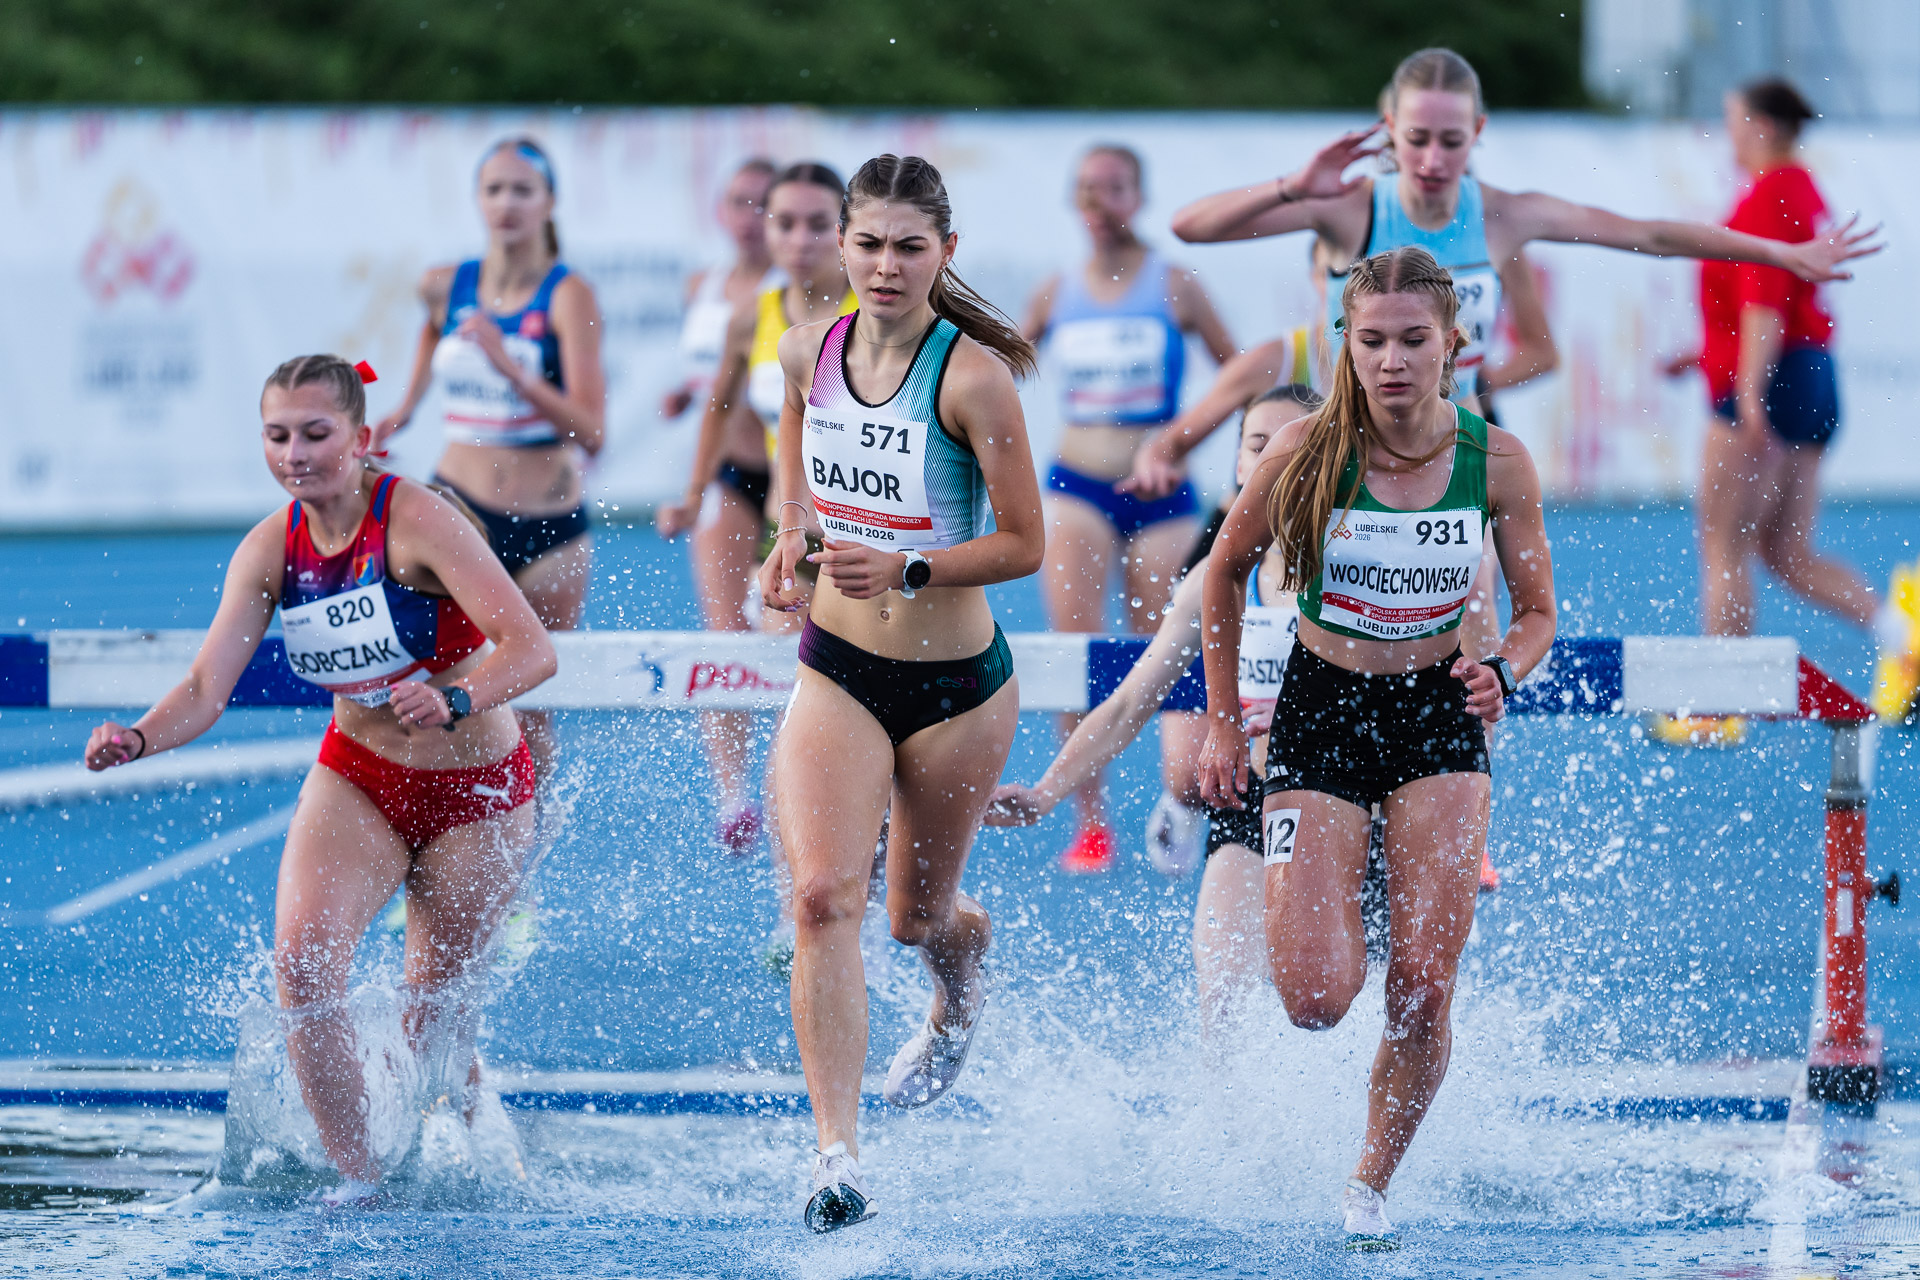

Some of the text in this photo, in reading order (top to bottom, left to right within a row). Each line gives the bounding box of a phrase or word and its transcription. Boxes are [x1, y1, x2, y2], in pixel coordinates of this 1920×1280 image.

[810, 416, 911, 454] LUBELSKIE 571
[812, 456, 903, 502] BAJOR
[835, 511, 865, 522] SPORTACH
[866, 518, 889, 527] LETNICH
[858, 510, 888, 521] OLIMPIADA
[825, 518, 895, 541] LUBLIN 2026
[1354, 533, 1371, 541] 2026
[1355, 519, 1468, 546] LUBELSKIE 931
[1329, 563, 1470, 595] WOJCIECHOWSKA
[326, 596, 375, 628] 820
[1331, 594, 1348, 602] XXXII
[1398, 607, 1430, 616] OLIMPIADA
[1371, 612, 1405, 622] SPORTACH
[1356, 618, 1432, 635] LUBLIN 2026
[289, 637, 401, 674] SOBCZAK
[1266, 817, 1296, 857] 12
